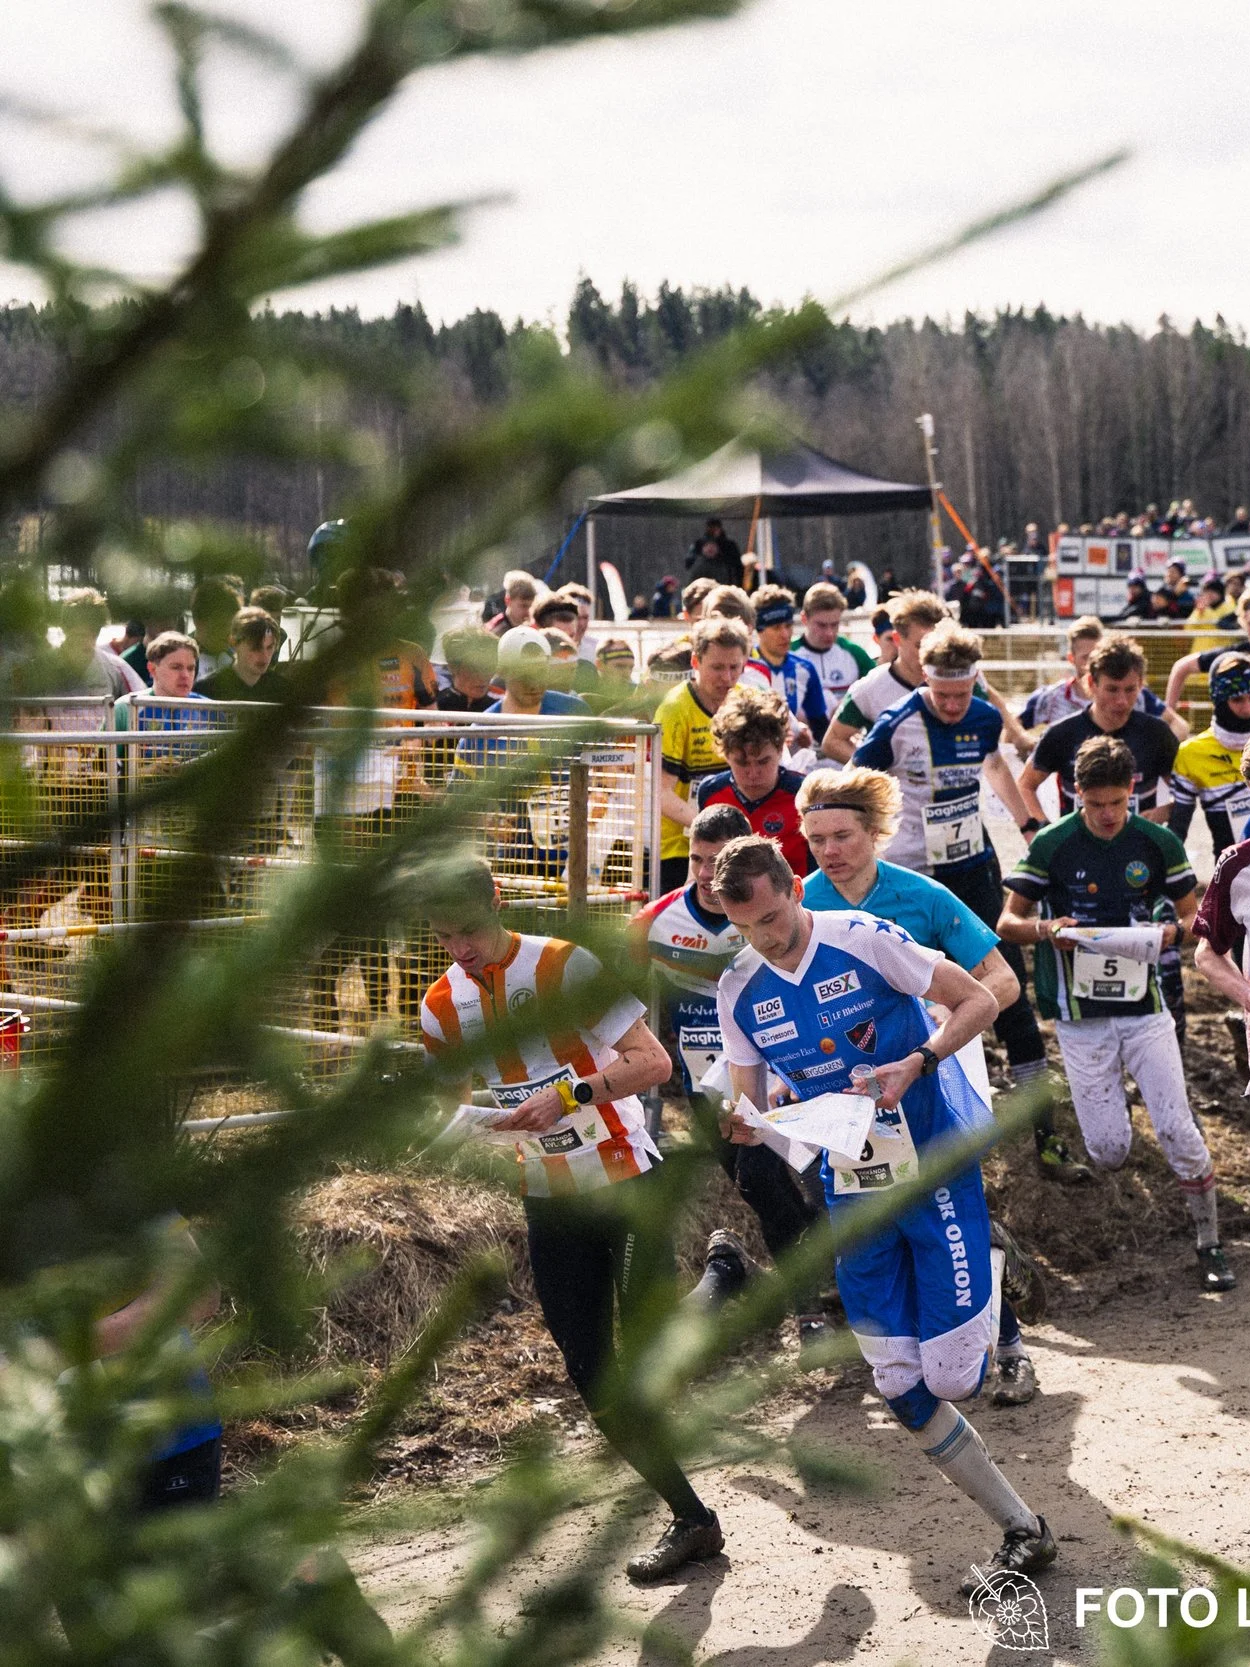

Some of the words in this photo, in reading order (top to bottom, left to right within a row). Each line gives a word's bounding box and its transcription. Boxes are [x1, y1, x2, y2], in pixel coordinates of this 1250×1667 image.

[951, 822, 963, 839] 7
[1103, 959, 1118, 977] 5
[757, 999, 780, 1015] iLOG
[681, 1031, 723, 1045] bagh
[934, 1186, 956, 1221] OK
[944, 1223, 973, 1308] ORION
